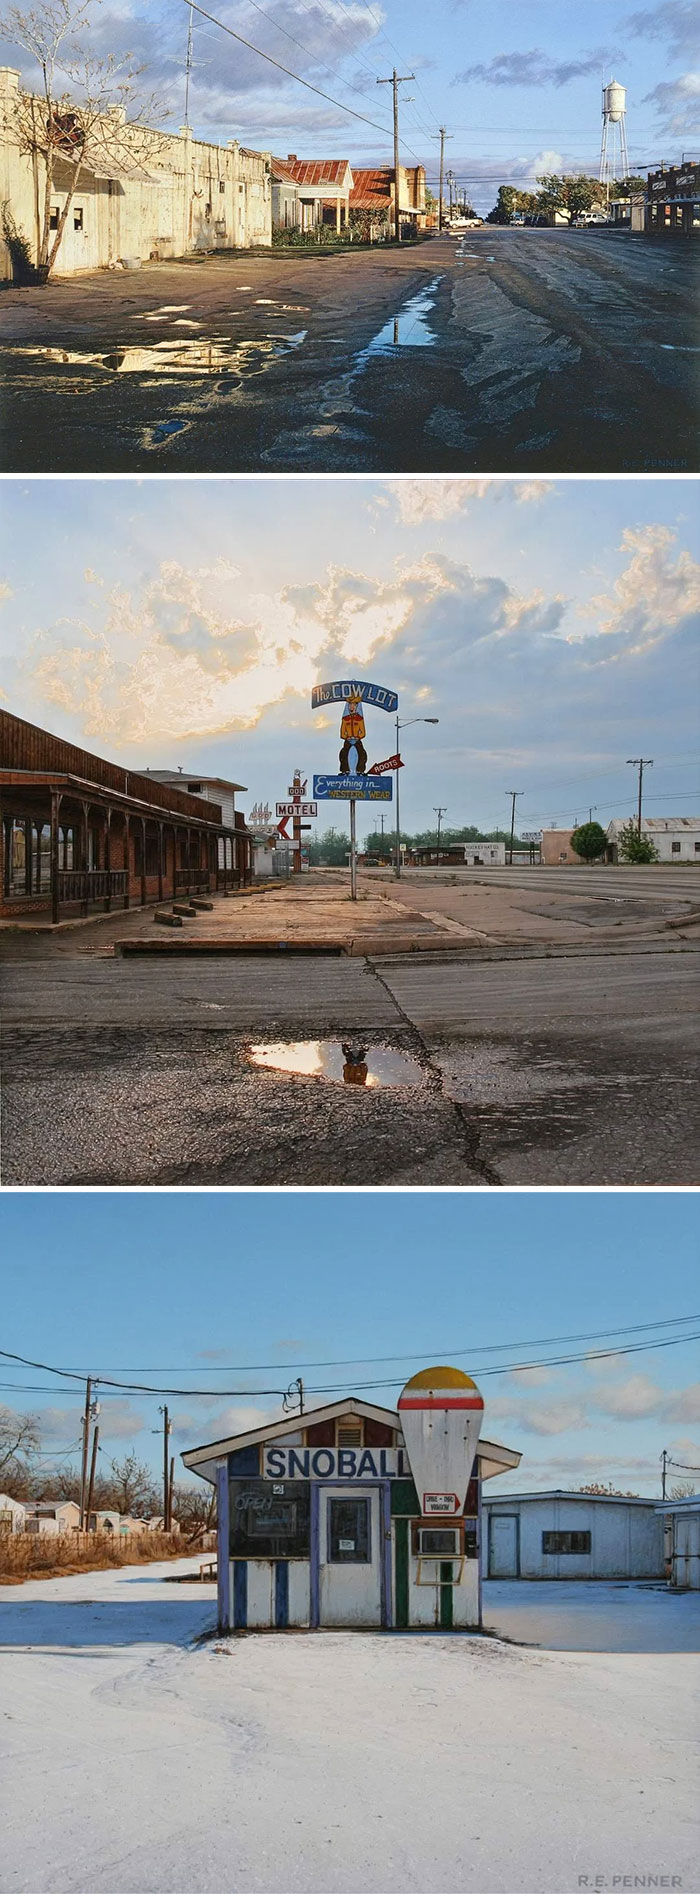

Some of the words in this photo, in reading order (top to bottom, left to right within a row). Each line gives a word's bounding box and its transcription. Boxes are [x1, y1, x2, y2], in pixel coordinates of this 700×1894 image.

[644, 459, 688, 468] PENNER
[313, 687, 330, 703] The
[315, 775, 365, 795] Everything
[328, 789, 366, 799] WESTERN
[368, 790, 391, 800] WEAR
[279, 805, 315, 815] MOTEL
[235, 1494, 272, 1510] OPEN
[577, 1875, 608, 1887] R.E.
[612, 1875, 683, 1888] PENNER
